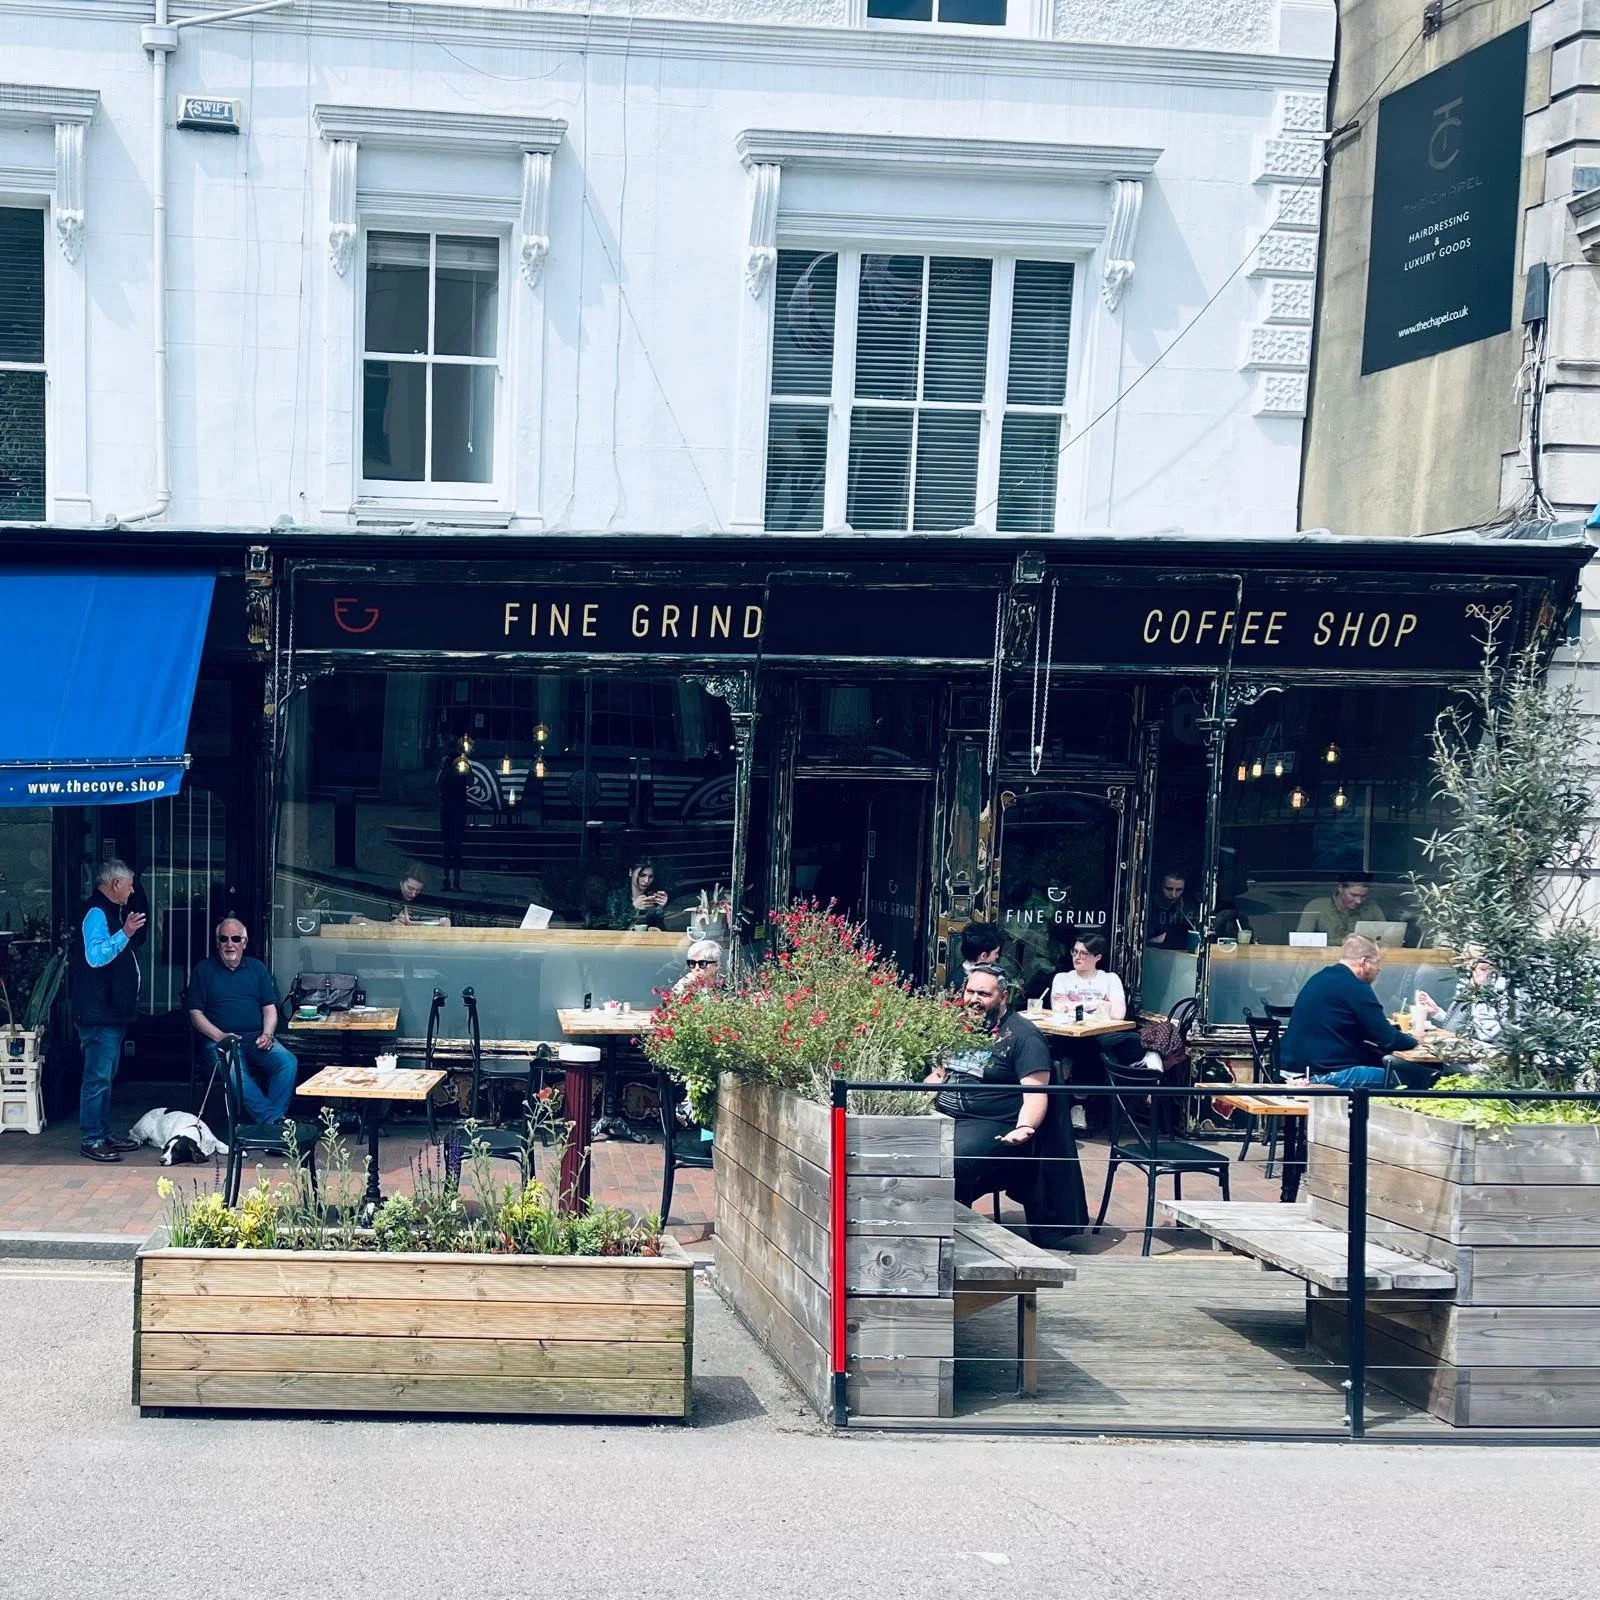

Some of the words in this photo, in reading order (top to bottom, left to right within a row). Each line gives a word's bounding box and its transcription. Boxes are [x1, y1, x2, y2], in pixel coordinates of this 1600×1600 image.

[192, 100, 231, 117] SWIFT
[1408, 211, 1470, 243] HAIRDRESSING
[1434, 237, 1440, 246] &
[1404, 251, 1436, 271] LUXURY
[1439, 237, 1471, 257] GOODS
[1398, 305, 1469, 337] www.thechapel.co.uk
[504, 602, 600, 636] FINE
[631, 604, 763, 639] GRIND
[1464, 602, 1513, 619] 90-92
[1143, 609, 1288, 645] COFFEE
[1313, 611, 1418, 648] SHOP
[27, 778, 166, 794] www.thecove.shop
[870, 898, 888, 915] FINE
[890, 901, 915, 919] GRIND
[1006, 909, 1044, 924] FINE
[1054, 910, 1107, 926] GRIND
